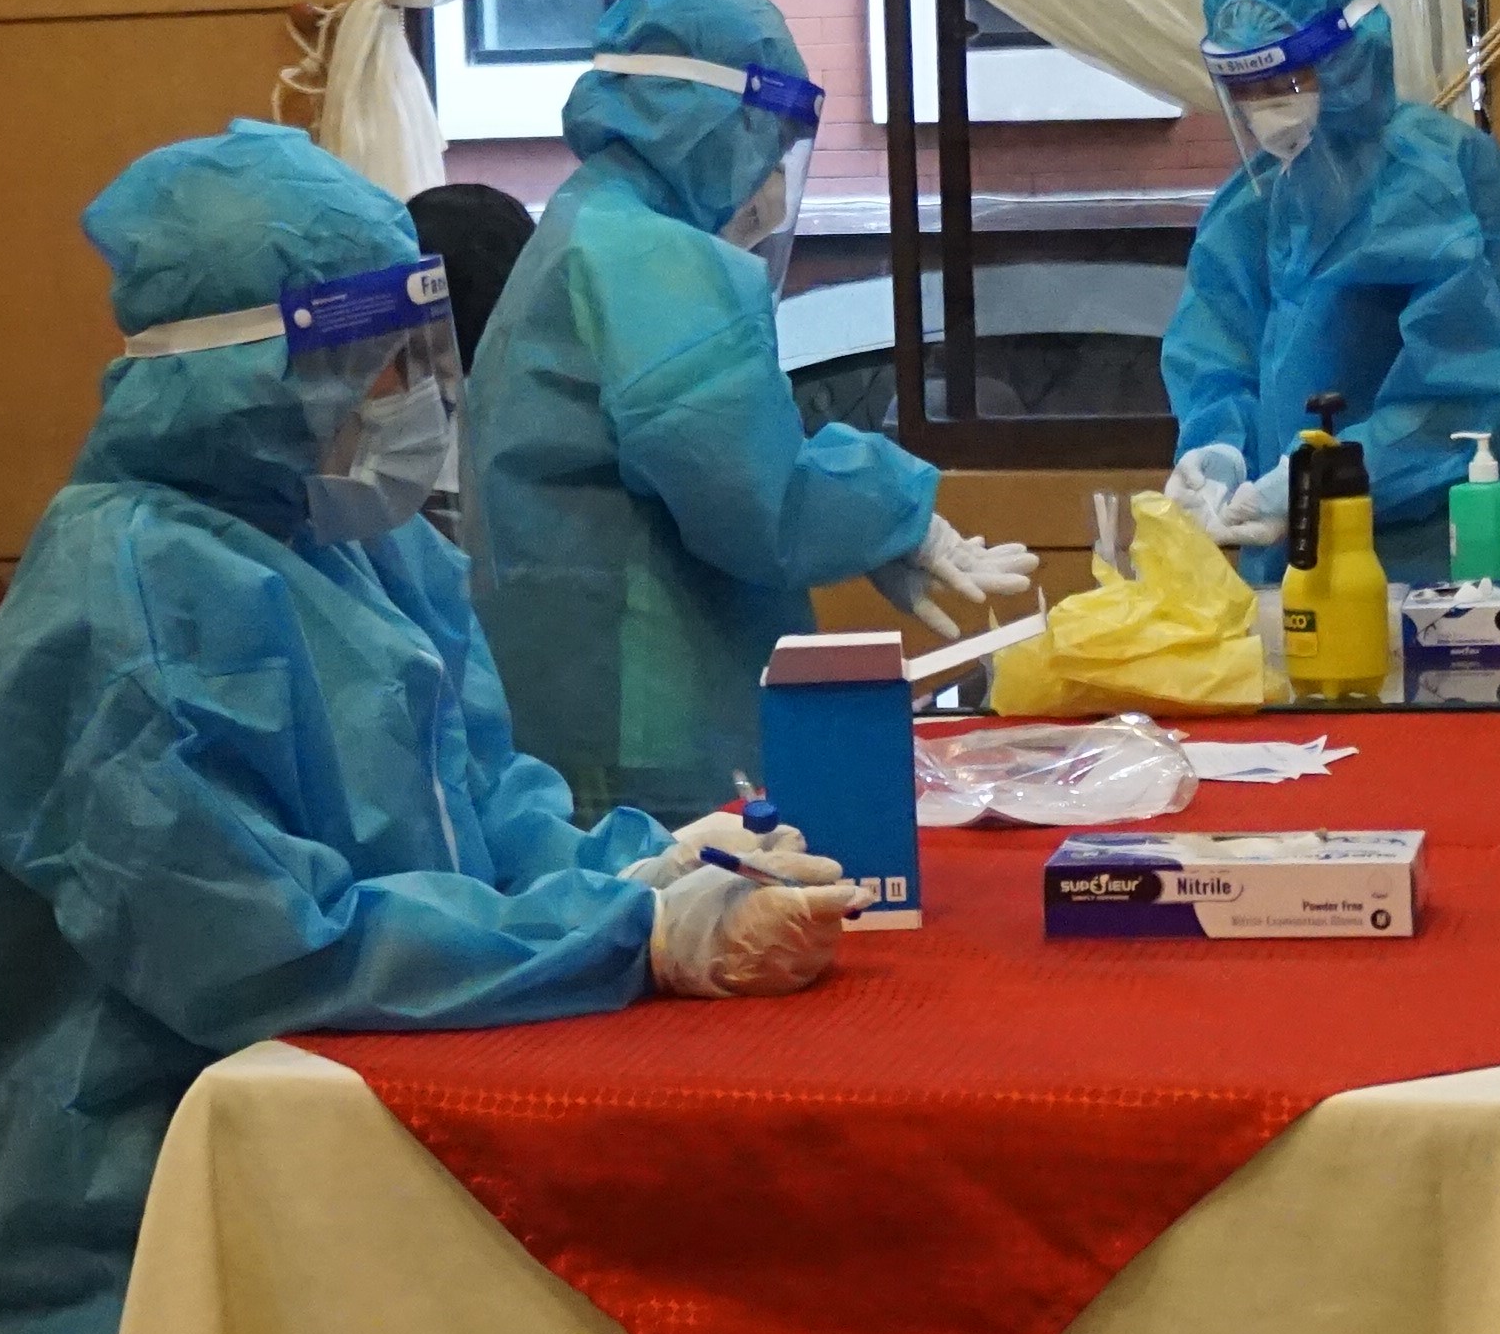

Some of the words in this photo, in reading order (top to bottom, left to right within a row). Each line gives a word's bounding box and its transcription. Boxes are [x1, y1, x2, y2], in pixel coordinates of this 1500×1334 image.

[1226, 53, 1274, 73] Shield
[1177, 877, 1232, 896] Nitrile
[1302, 899, 1338, 912] Powder
